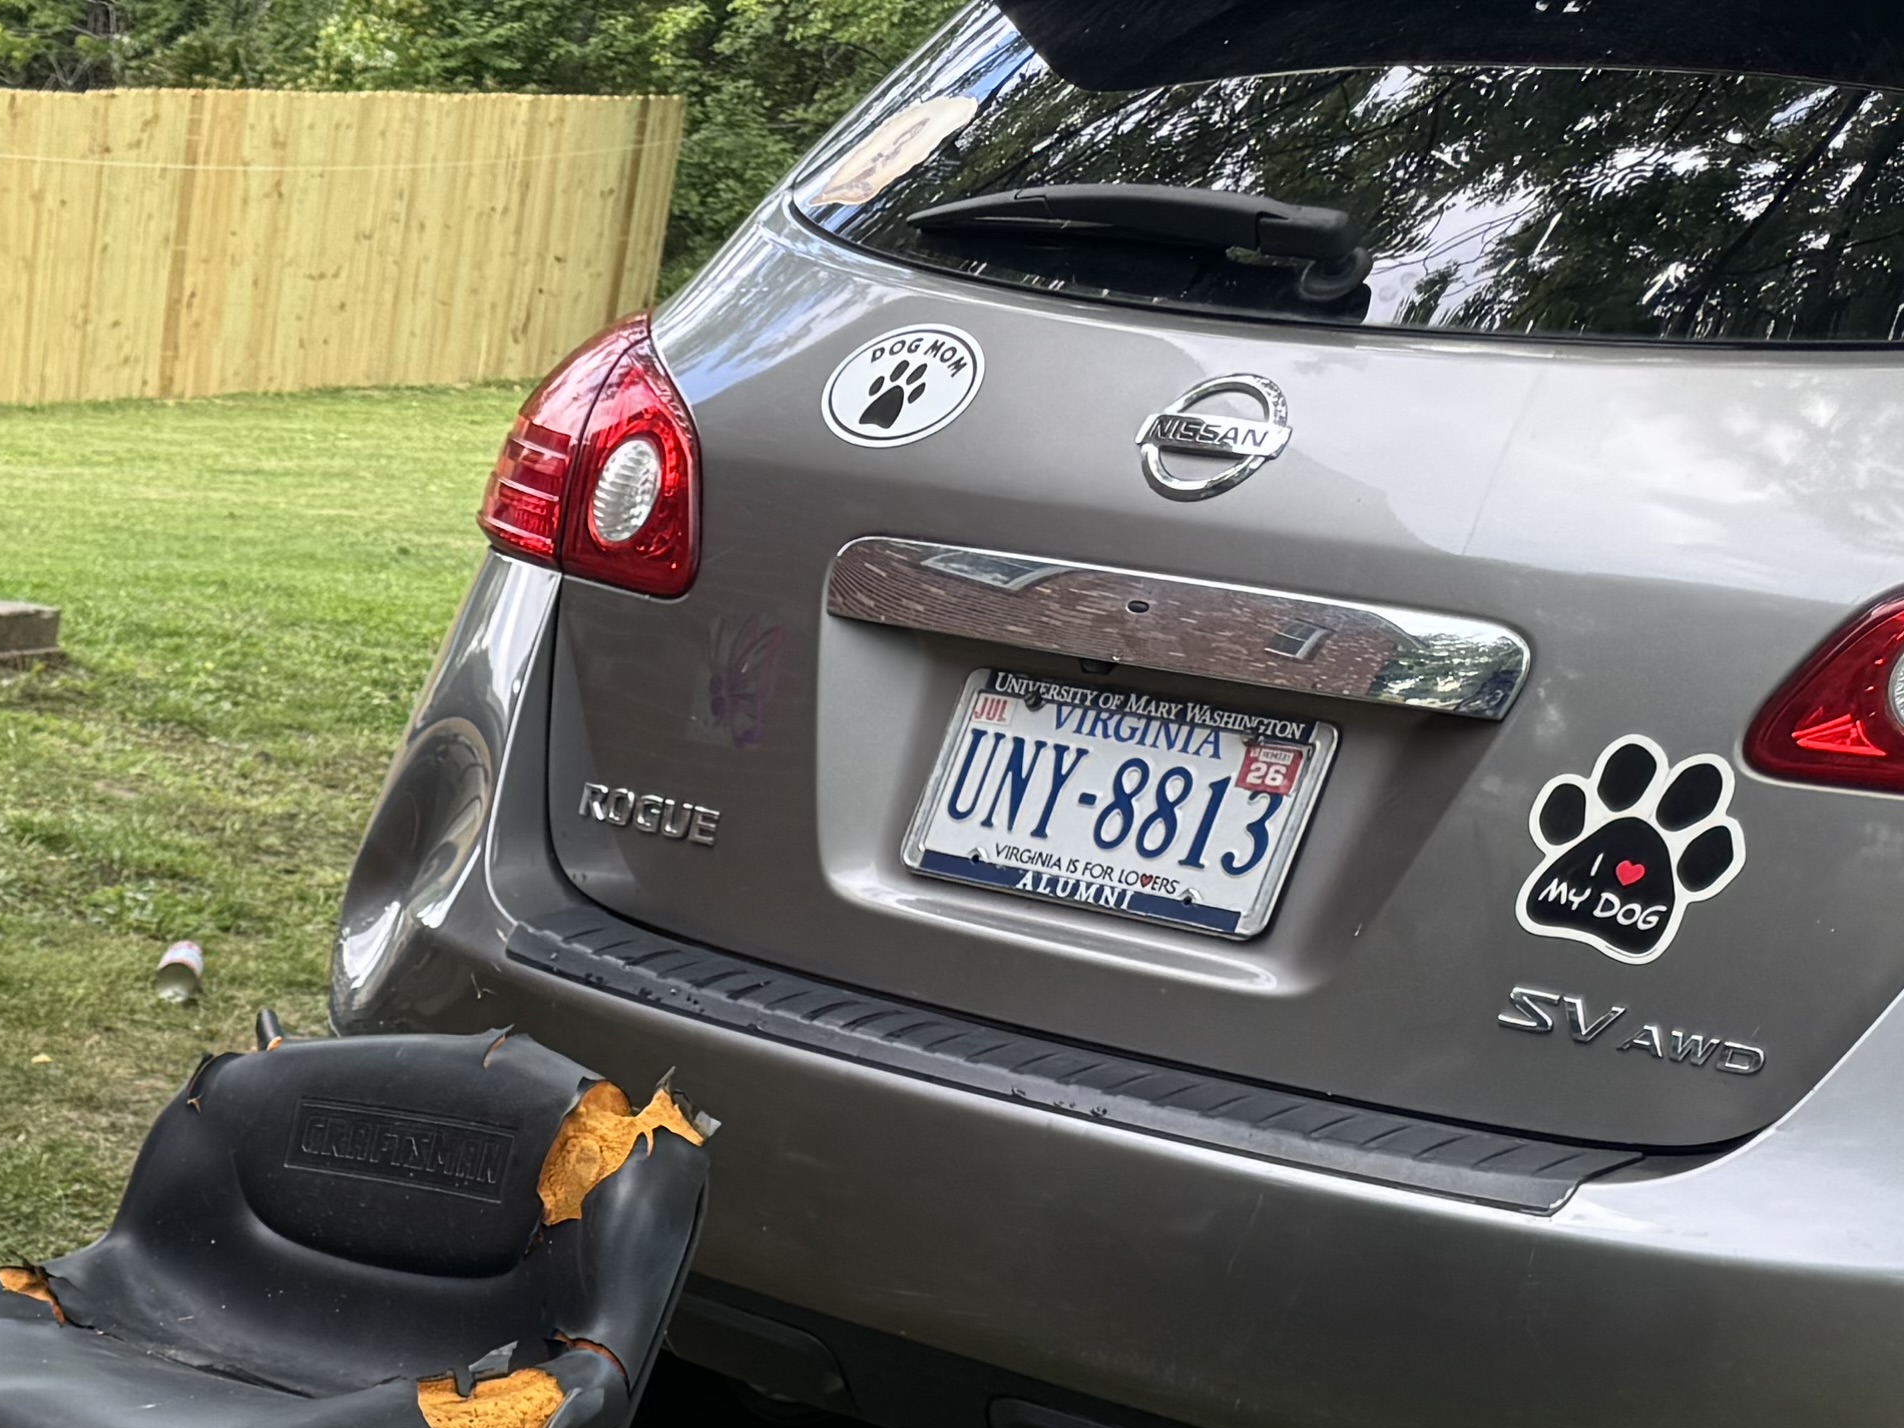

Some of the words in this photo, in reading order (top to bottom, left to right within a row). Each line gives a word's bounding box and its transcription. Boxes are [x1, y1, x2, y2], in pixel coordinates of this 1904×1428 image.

[870, 337, 923, 364] DOG
[925, 339, 969, 378] MOM
[1148, 416, 1269, 449] NISSAN
[974, 697, 1009, 722] JUL
[1053, 703, 1222, 760] VIRGINIA
[1246, 761, 1287, 787] 26
[578, 781, 720, 847] ROGUE
[947, 729, 1284, 877] UNY-8813
[995, 842, 1062, 872] VIRGINIA
[1066, 859, 1079, 874] IS
[1082, 861, 1113, 882] FOR
[1590, 853, 1604, 877] I
[1015, 871, 1133, 911] ALUMNI
[1592, 891, 1667, 931] DOG
[1496, 985, 1626, 1044] SV
[1616, 1024, 1766, 1075] AWD
[301, 1115, 501, 1184] CRAFTSMAN
